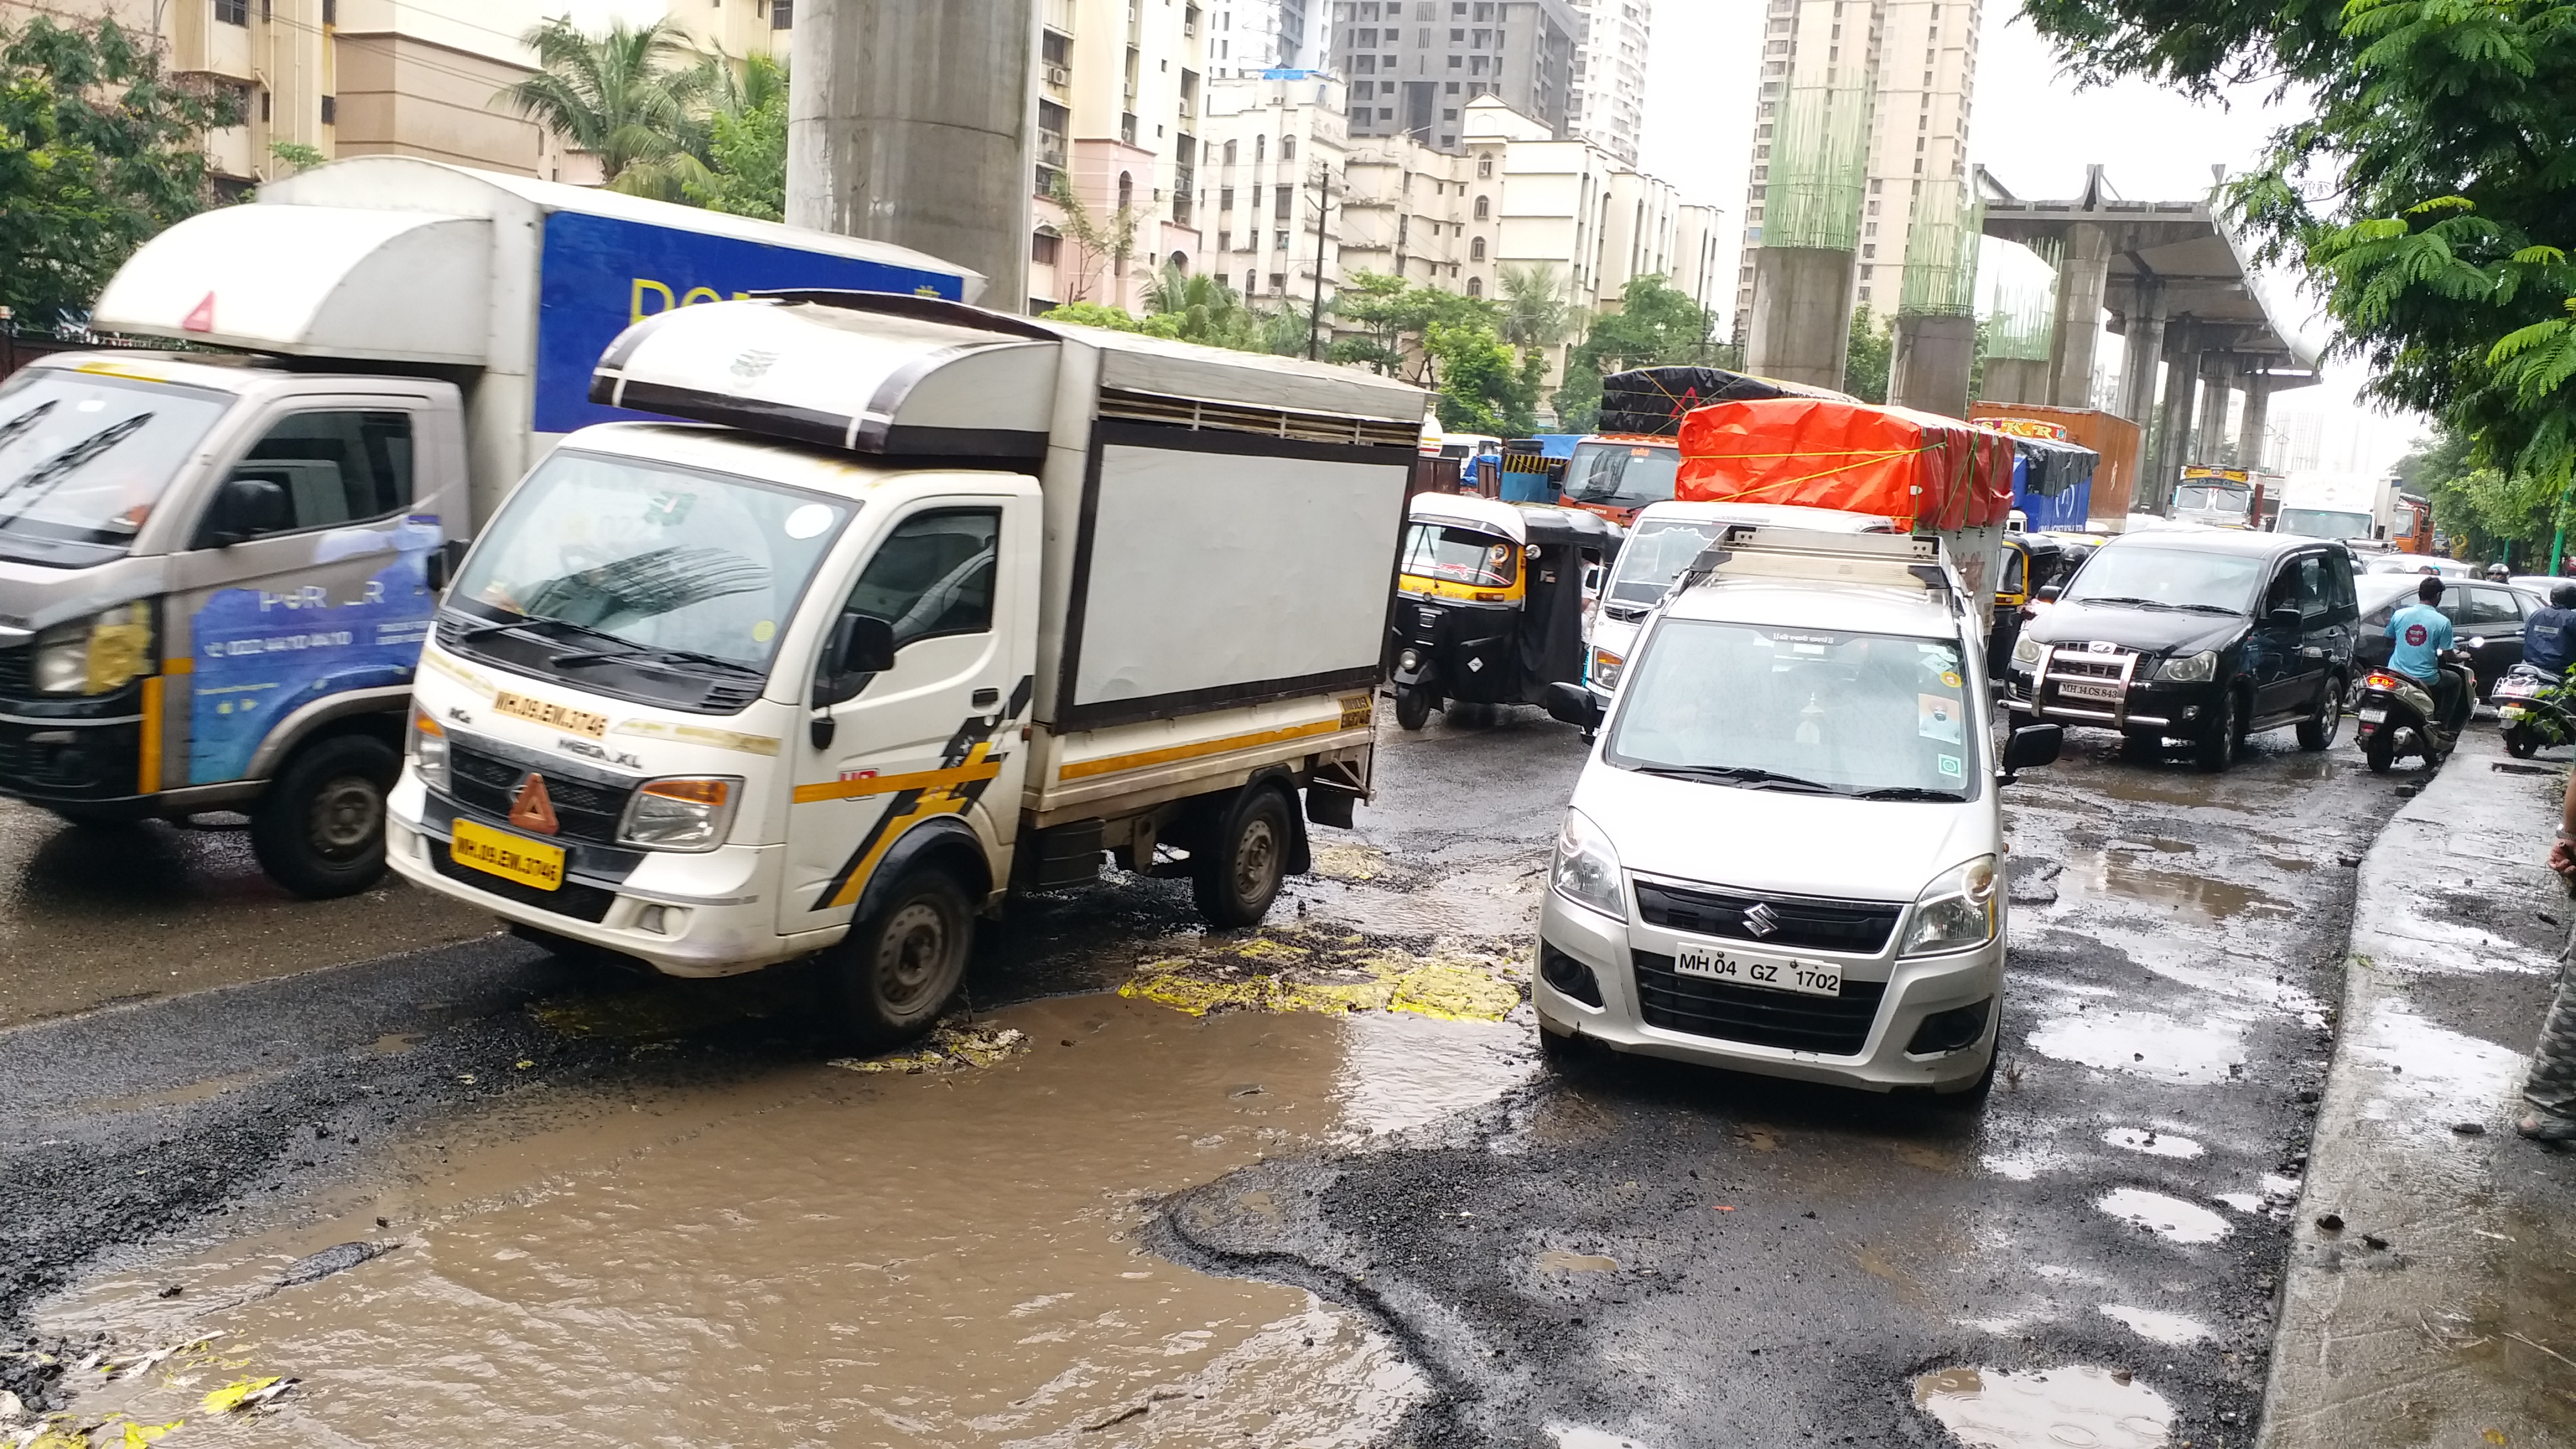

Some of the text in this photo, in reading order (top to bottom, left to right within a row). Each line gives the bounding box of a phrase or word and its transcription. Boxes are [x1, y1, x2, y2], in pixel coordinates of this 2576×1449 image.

[1679, 953, 1839, 991] MH 04 GZ 1702
